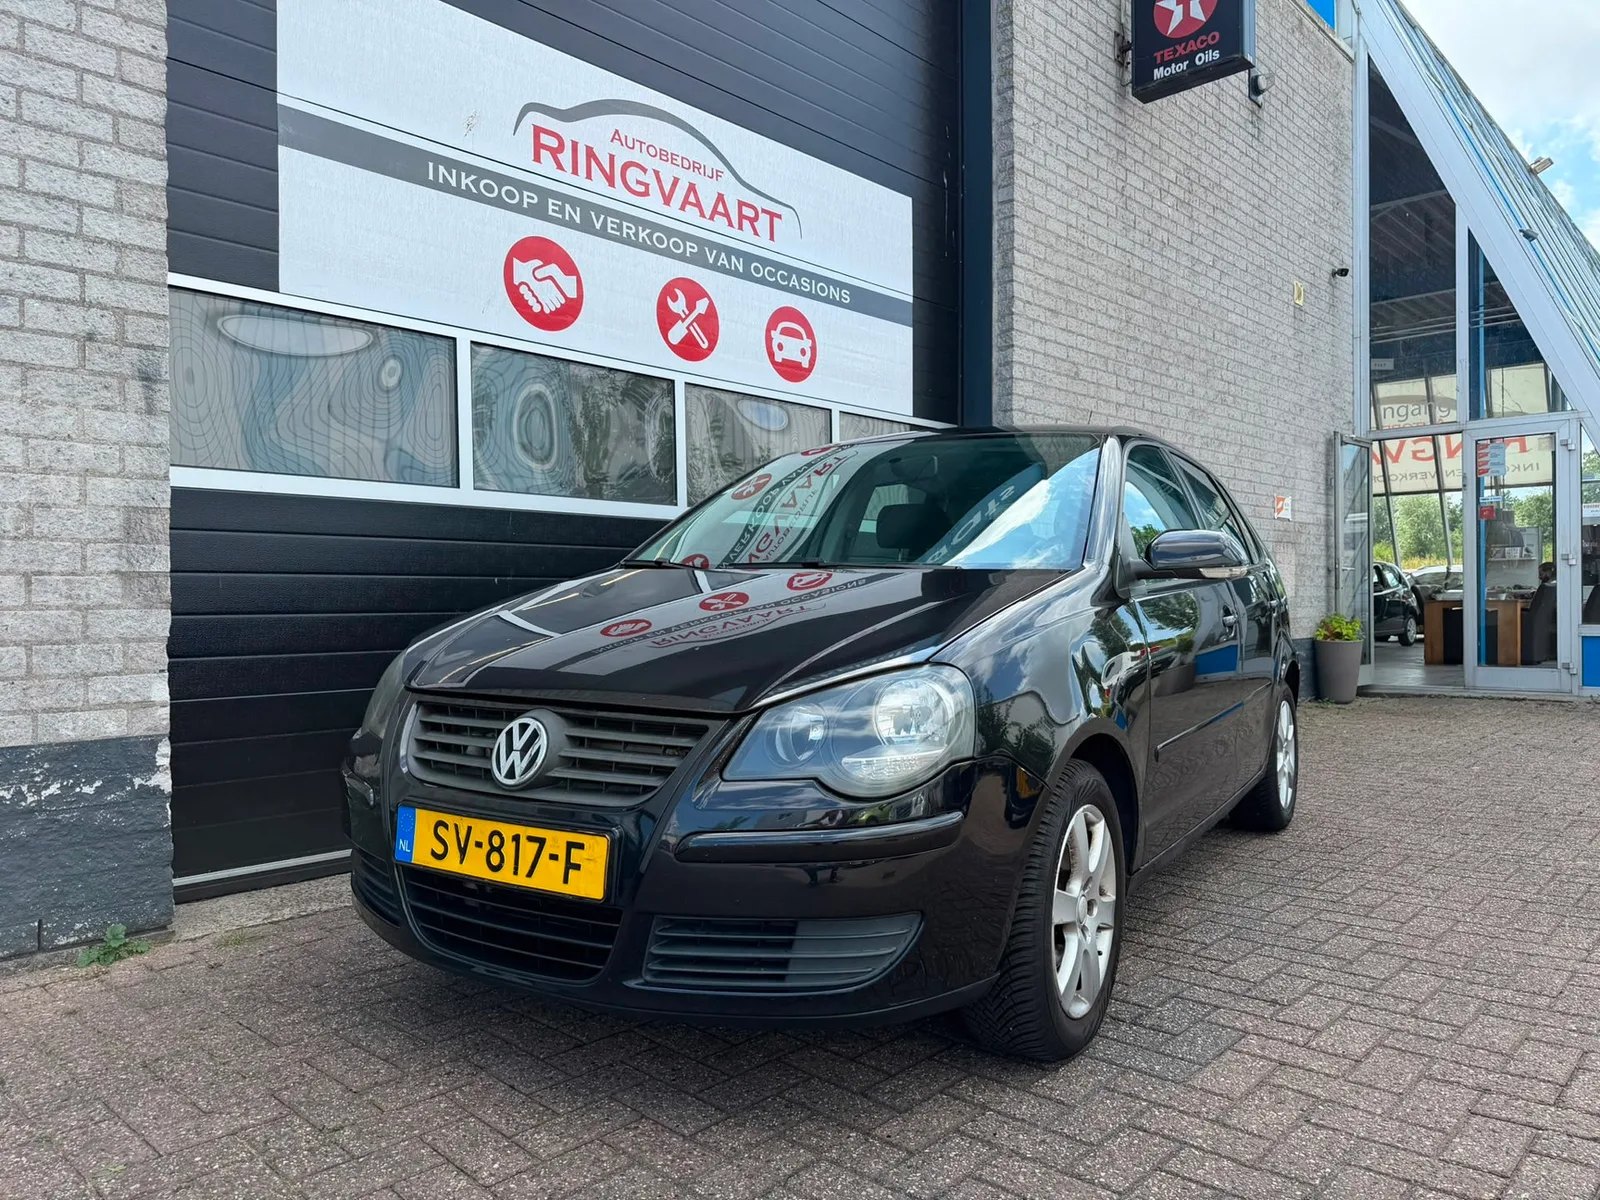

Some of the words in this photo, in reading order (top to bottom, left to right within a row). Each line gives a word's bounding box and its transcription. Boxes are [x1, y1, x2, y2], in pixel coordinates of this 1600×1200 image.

[1153, 31, 1220, 64] TEXACO
[1153, 60, 1189, 80] Motor
[1195, 49, 1220, 66] Oils
[610, 129, 725, 182] AUTOBEDRIJF
[532, 124, 783, 242] RINGVAART
[428, 161, 539, 209] INKOOP
[548, 201, 581, 225] EN
[592, 212, 699, 258] VERKOOP
[705, 247, 744, 274] VAN
[751, 262, 852, 305] OCCASIONS
[399, 839, 411, 852] NL
[430, 819, 585, 885] SV-817-F
